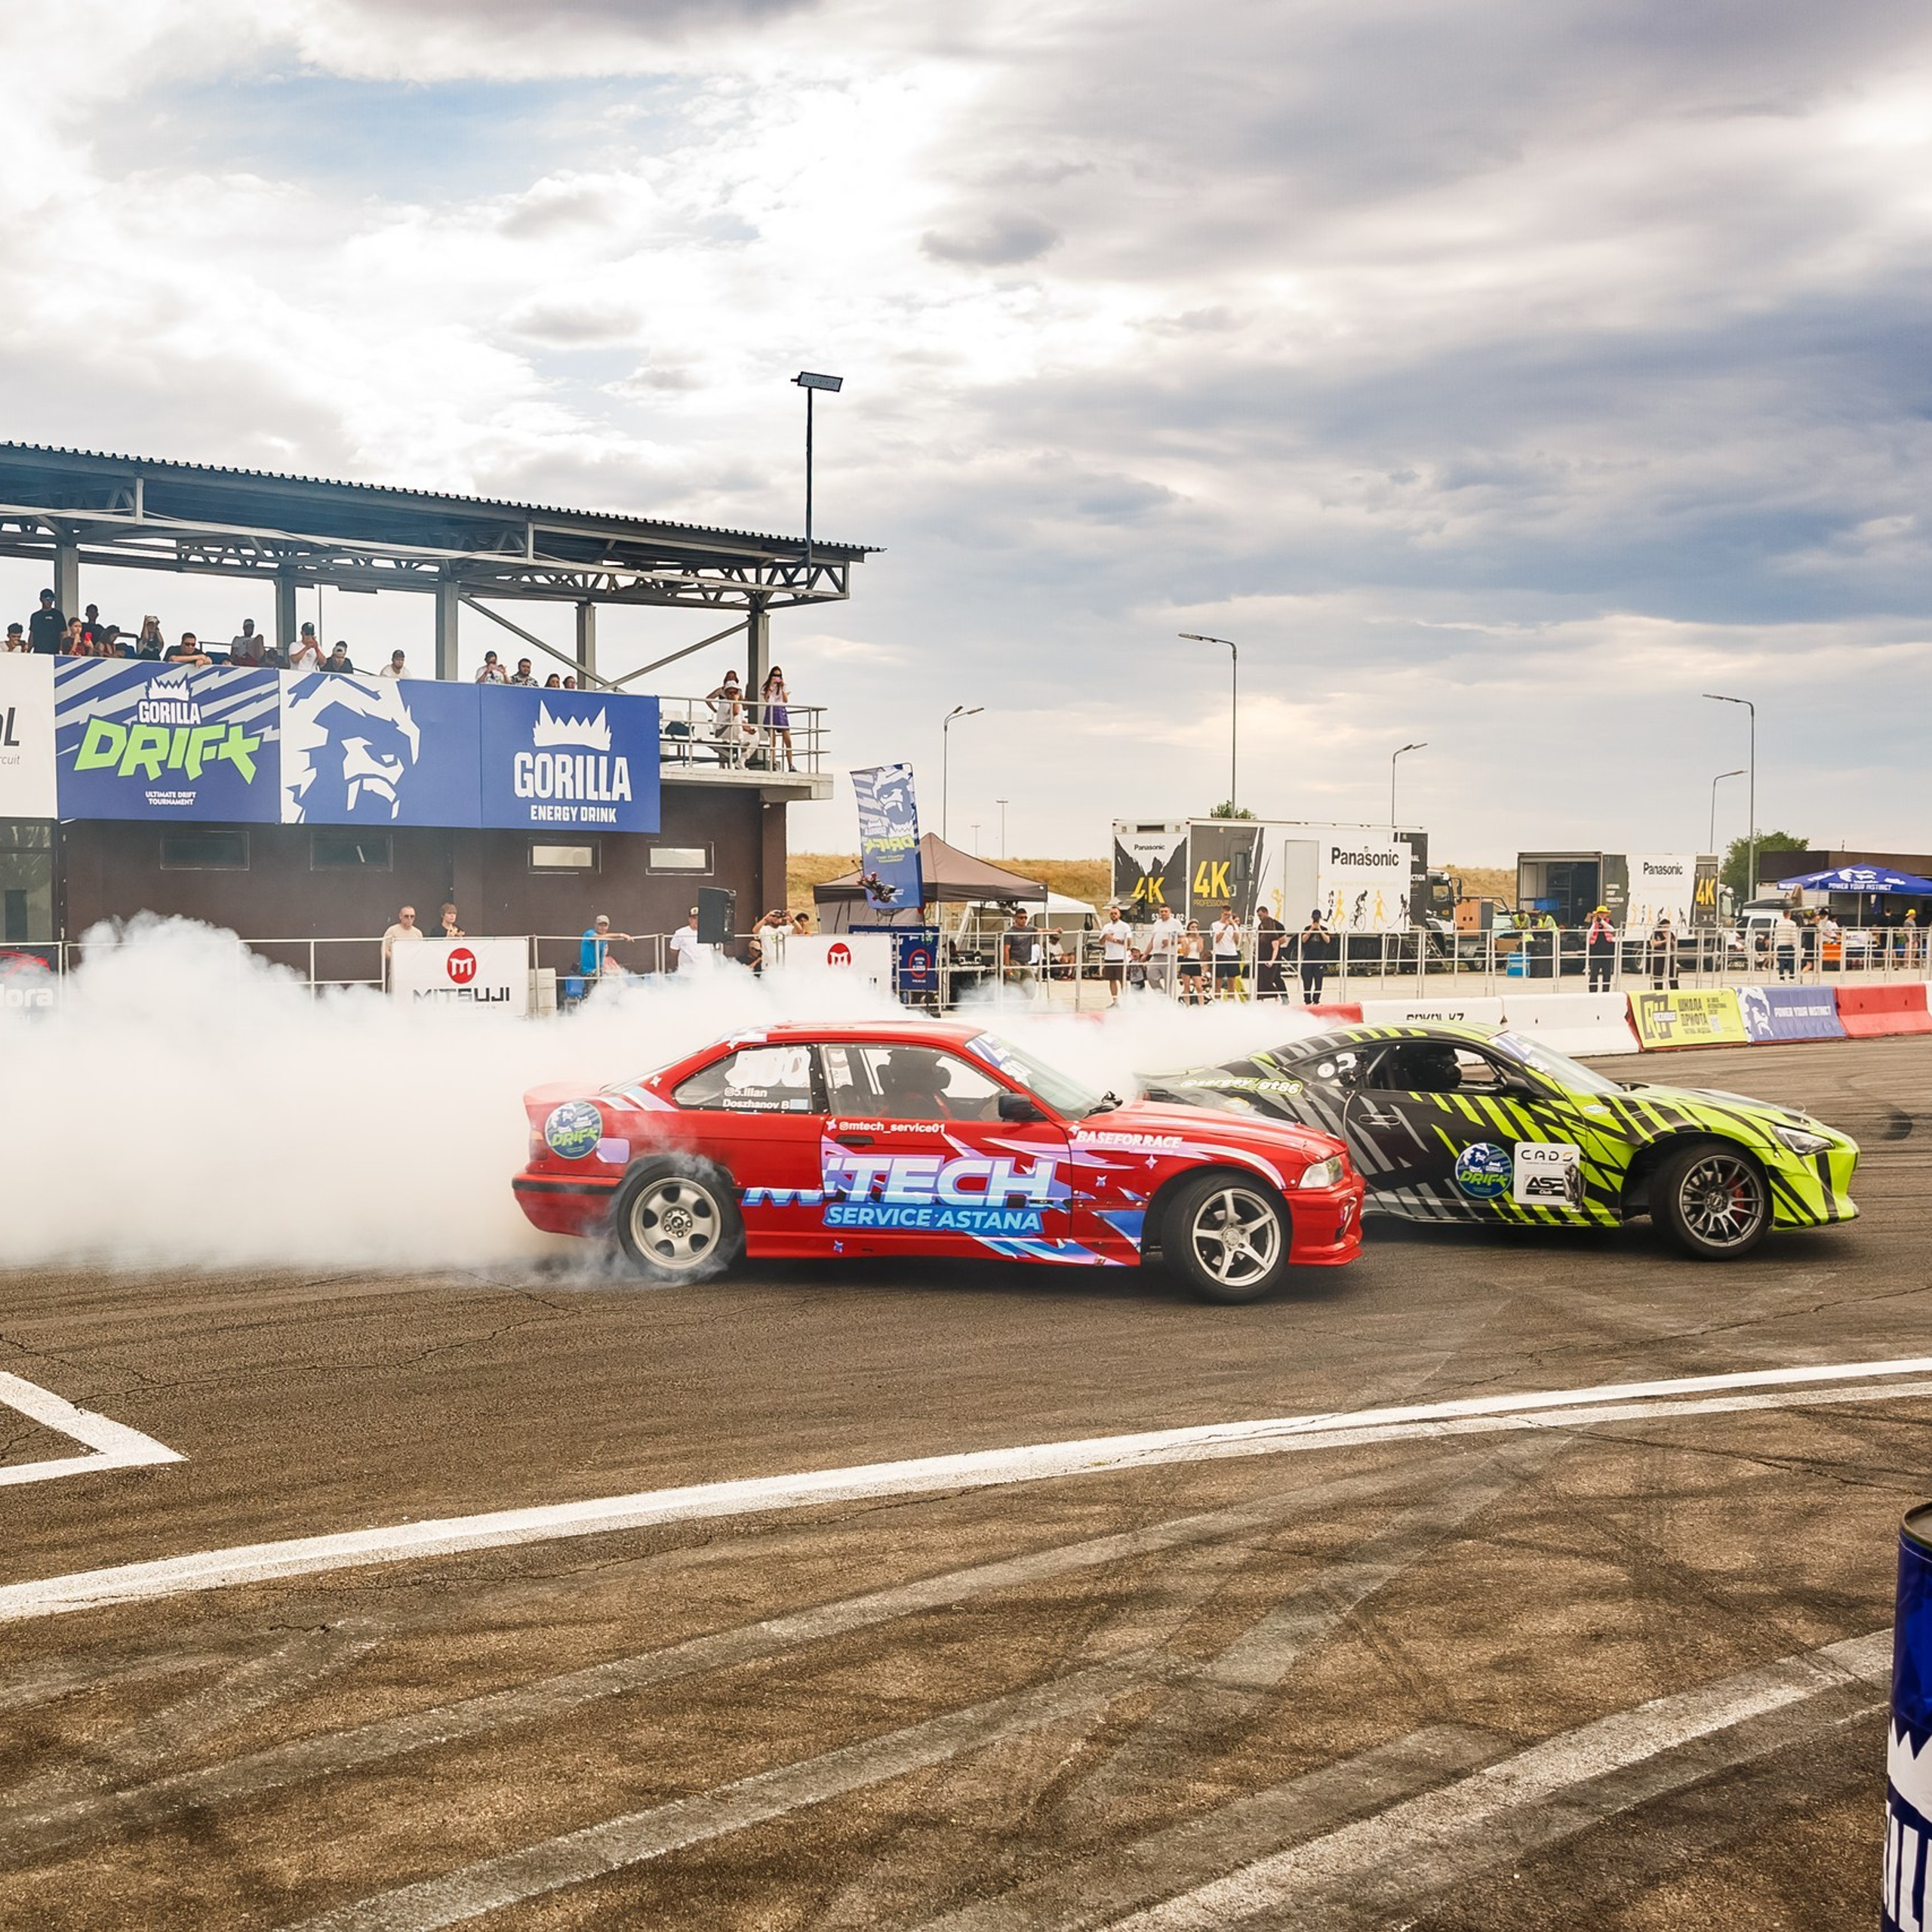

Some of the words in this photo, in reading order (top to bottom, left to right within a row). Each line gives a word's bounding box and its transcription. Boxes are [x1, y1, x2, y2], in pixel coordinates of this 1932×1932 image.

[139, 701, 201, 724] GORILLA
[0, 755, 20, 765] cuit
[74, 718, 260, 785] DRIFT
[514, 752, 632, 801] GORILLA
[531, 805, 579, 822] ENERGY
[580, 807, 617, 823] DRINK
[1331, 847, 1399, 866] Panasonic
[1643, 862, 1683, 875] Panasonic
[1193, 860, 1230, 898] 4K
[1695, 878, 1715, 905] 4K
[413, 986, 509, 1004] MITSUJI
[1774, 1007, 1793, 1017] POWER
[552, 1128, 598, 1146] DRIFT
[1076, 1131, 1183, 1149] BASEFORRACE
[1521, 1150, 1574, 1161] CADS
[1459, 1171, 1509, 1188] DRIFT
[826, 1207, 934, 1228] SERVICE
[936, 1211, 1041, 1230] ASTANA
